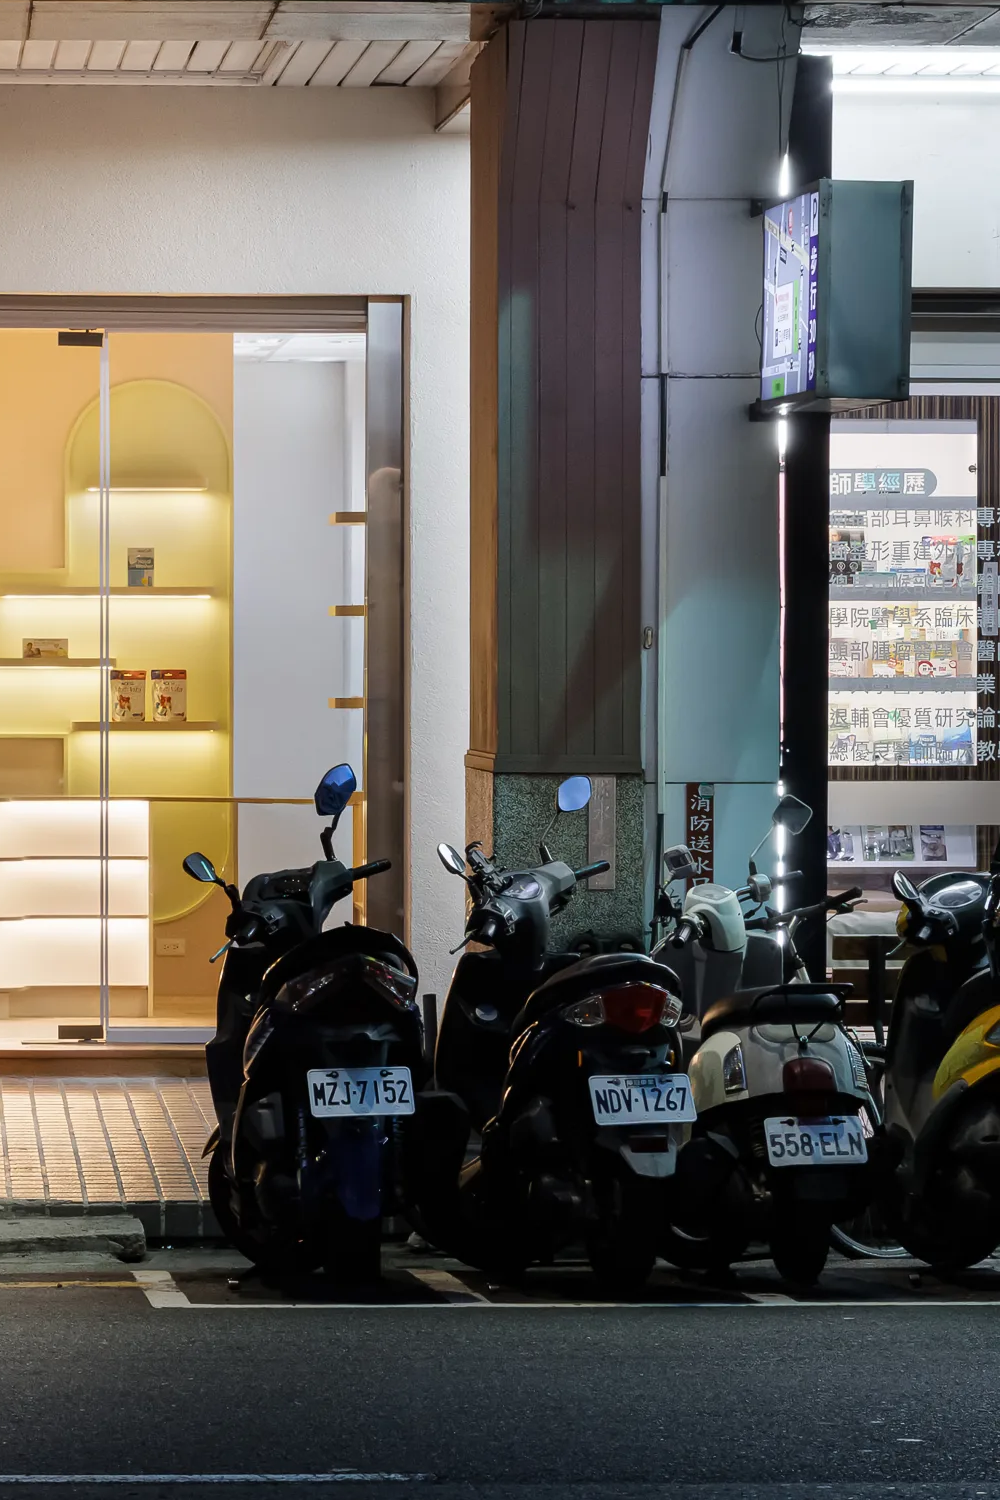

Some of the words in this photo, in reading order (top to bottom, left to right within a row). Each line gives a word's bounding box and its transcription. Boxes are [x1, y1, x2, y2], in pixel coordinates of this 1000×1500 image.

[830, 472, 926, 496] 師學經歷
[830, 706, 1000, 729] 退輔會優質研究論
